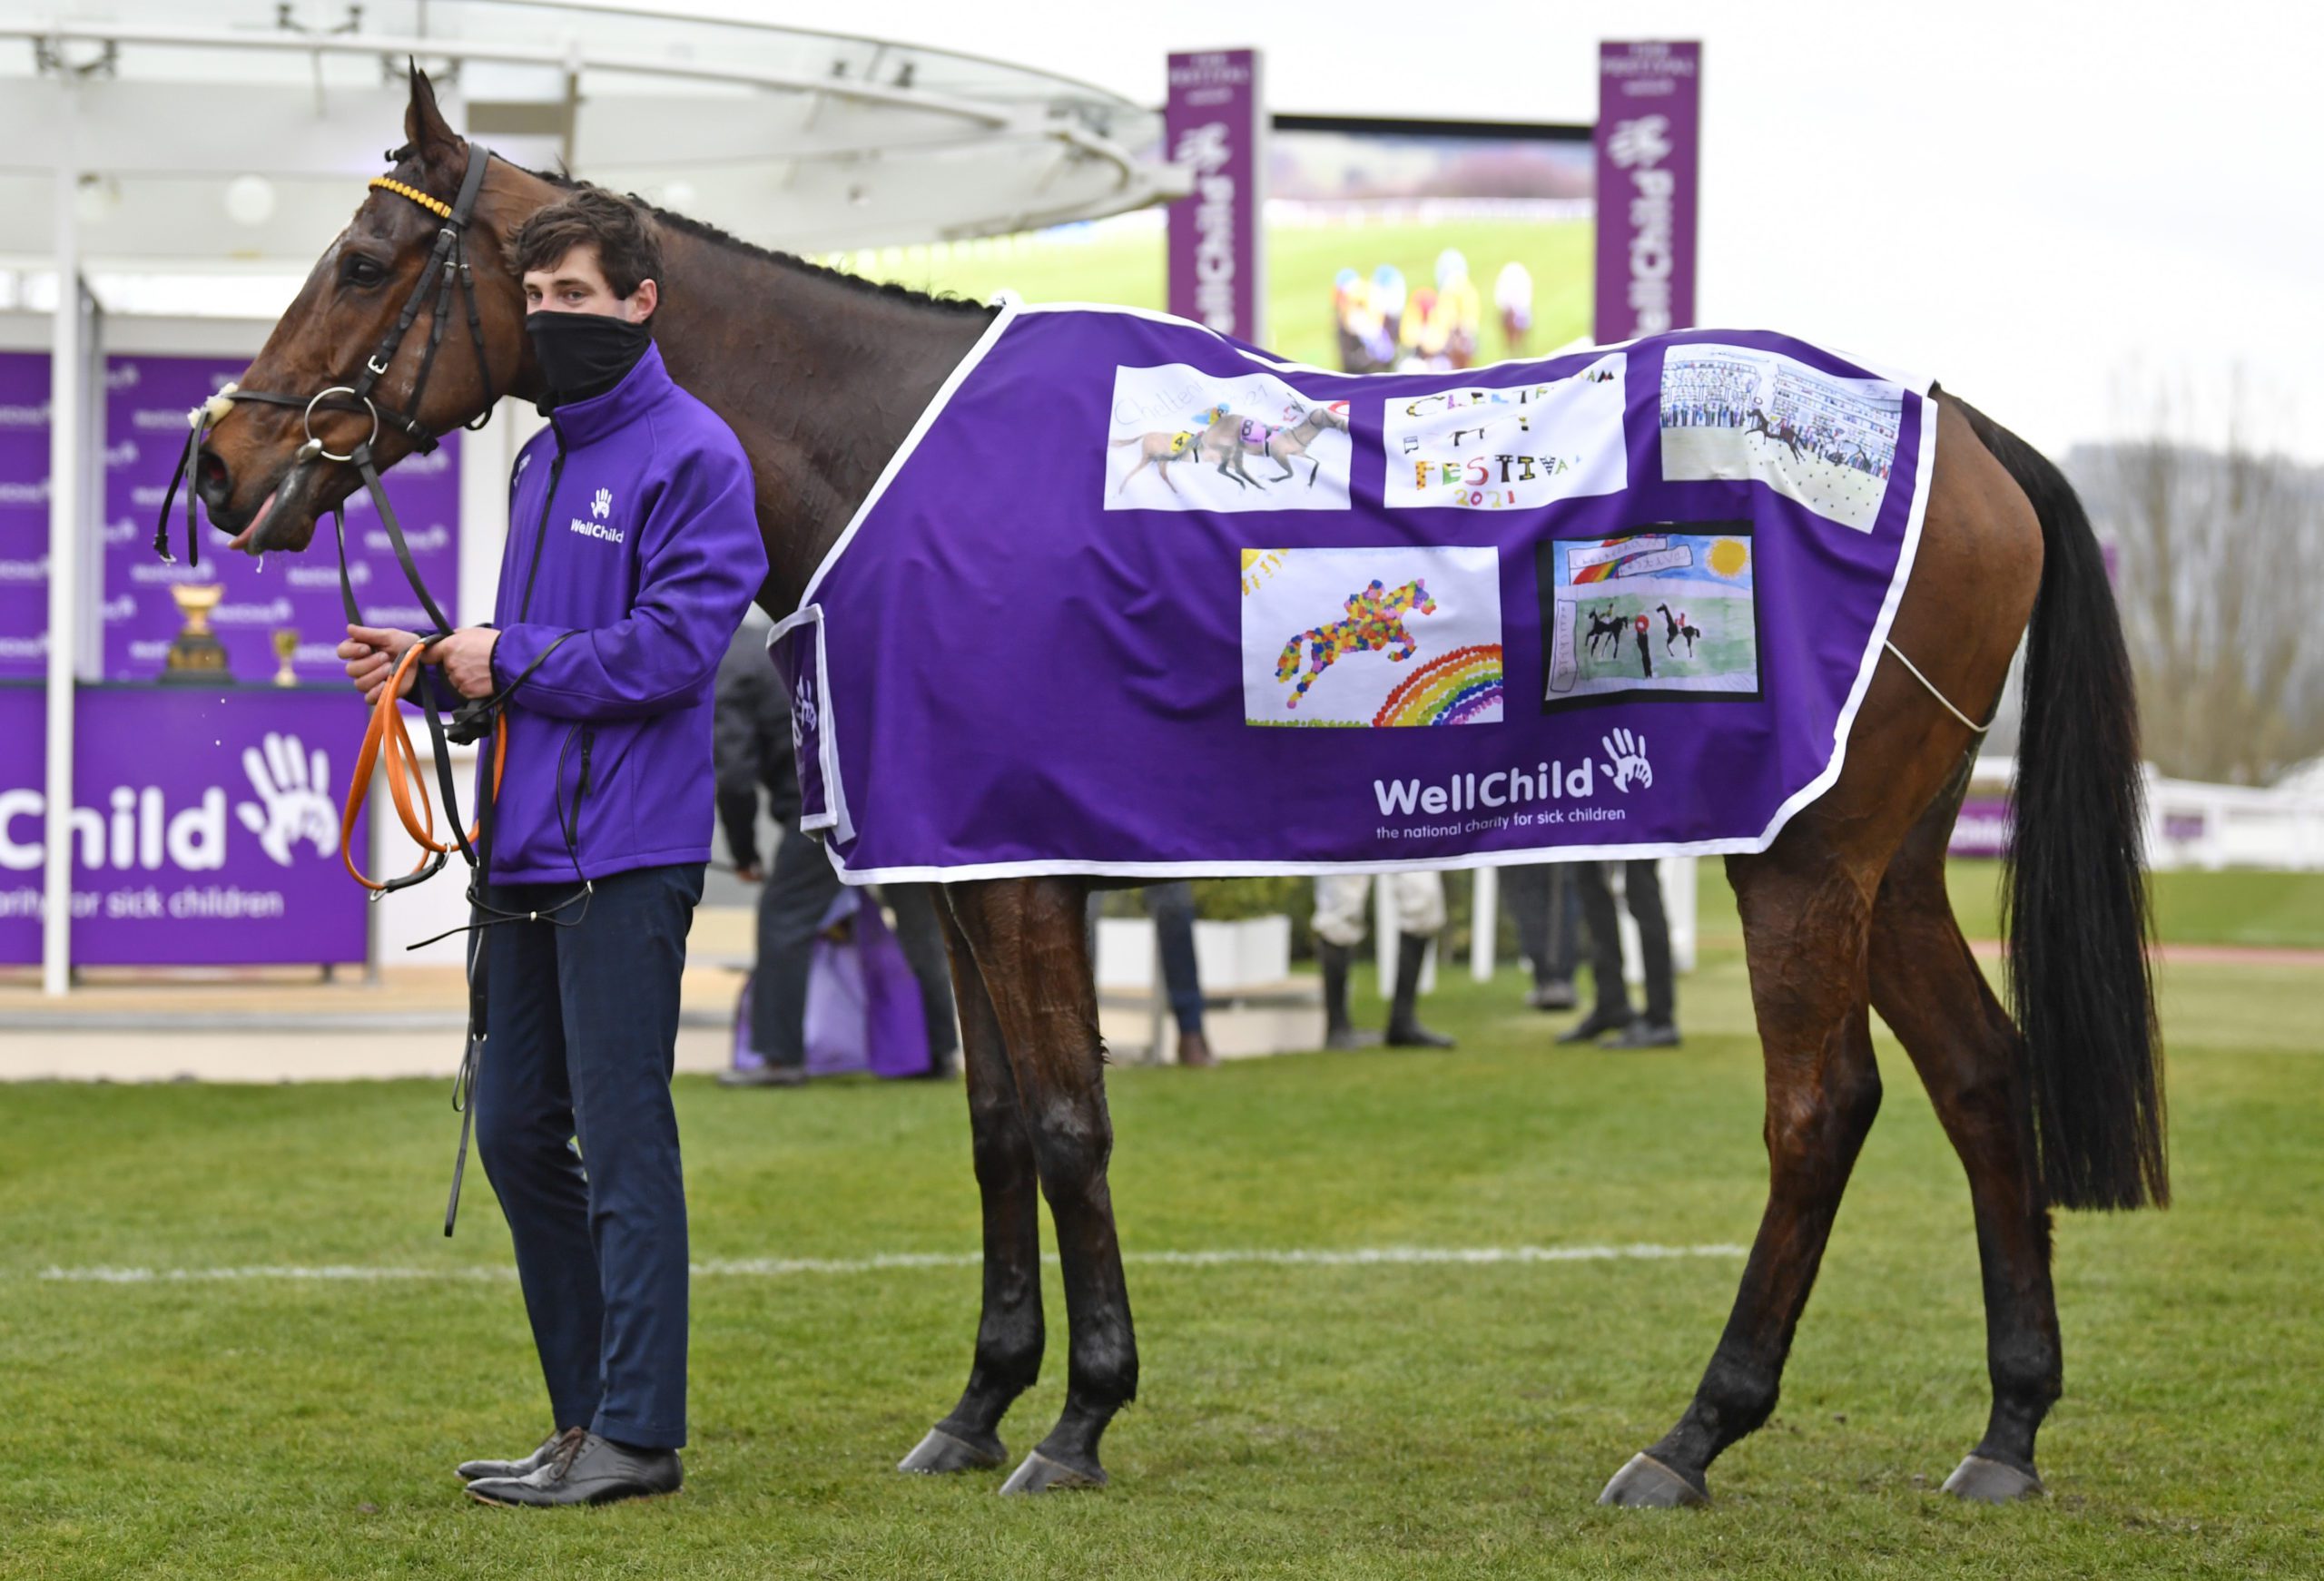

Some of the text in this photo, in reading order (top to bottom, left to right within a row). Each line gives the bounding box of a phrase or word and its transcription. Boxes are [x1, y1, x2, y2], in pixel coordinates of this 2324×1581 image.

[1195, 174, 1235, 334] ellChild
[1628, 169, 1673, 339] ellChild
[1454, 489, 1516, 508] 2021
[570, 518, 625, 544] WellChild
[1374, 757, 1593, 816] WellChild
[1376, 807, 1626, 840] the national charity for sick children
[105, 885, 165, 919] sick
[168, 884, 285, 919] children
